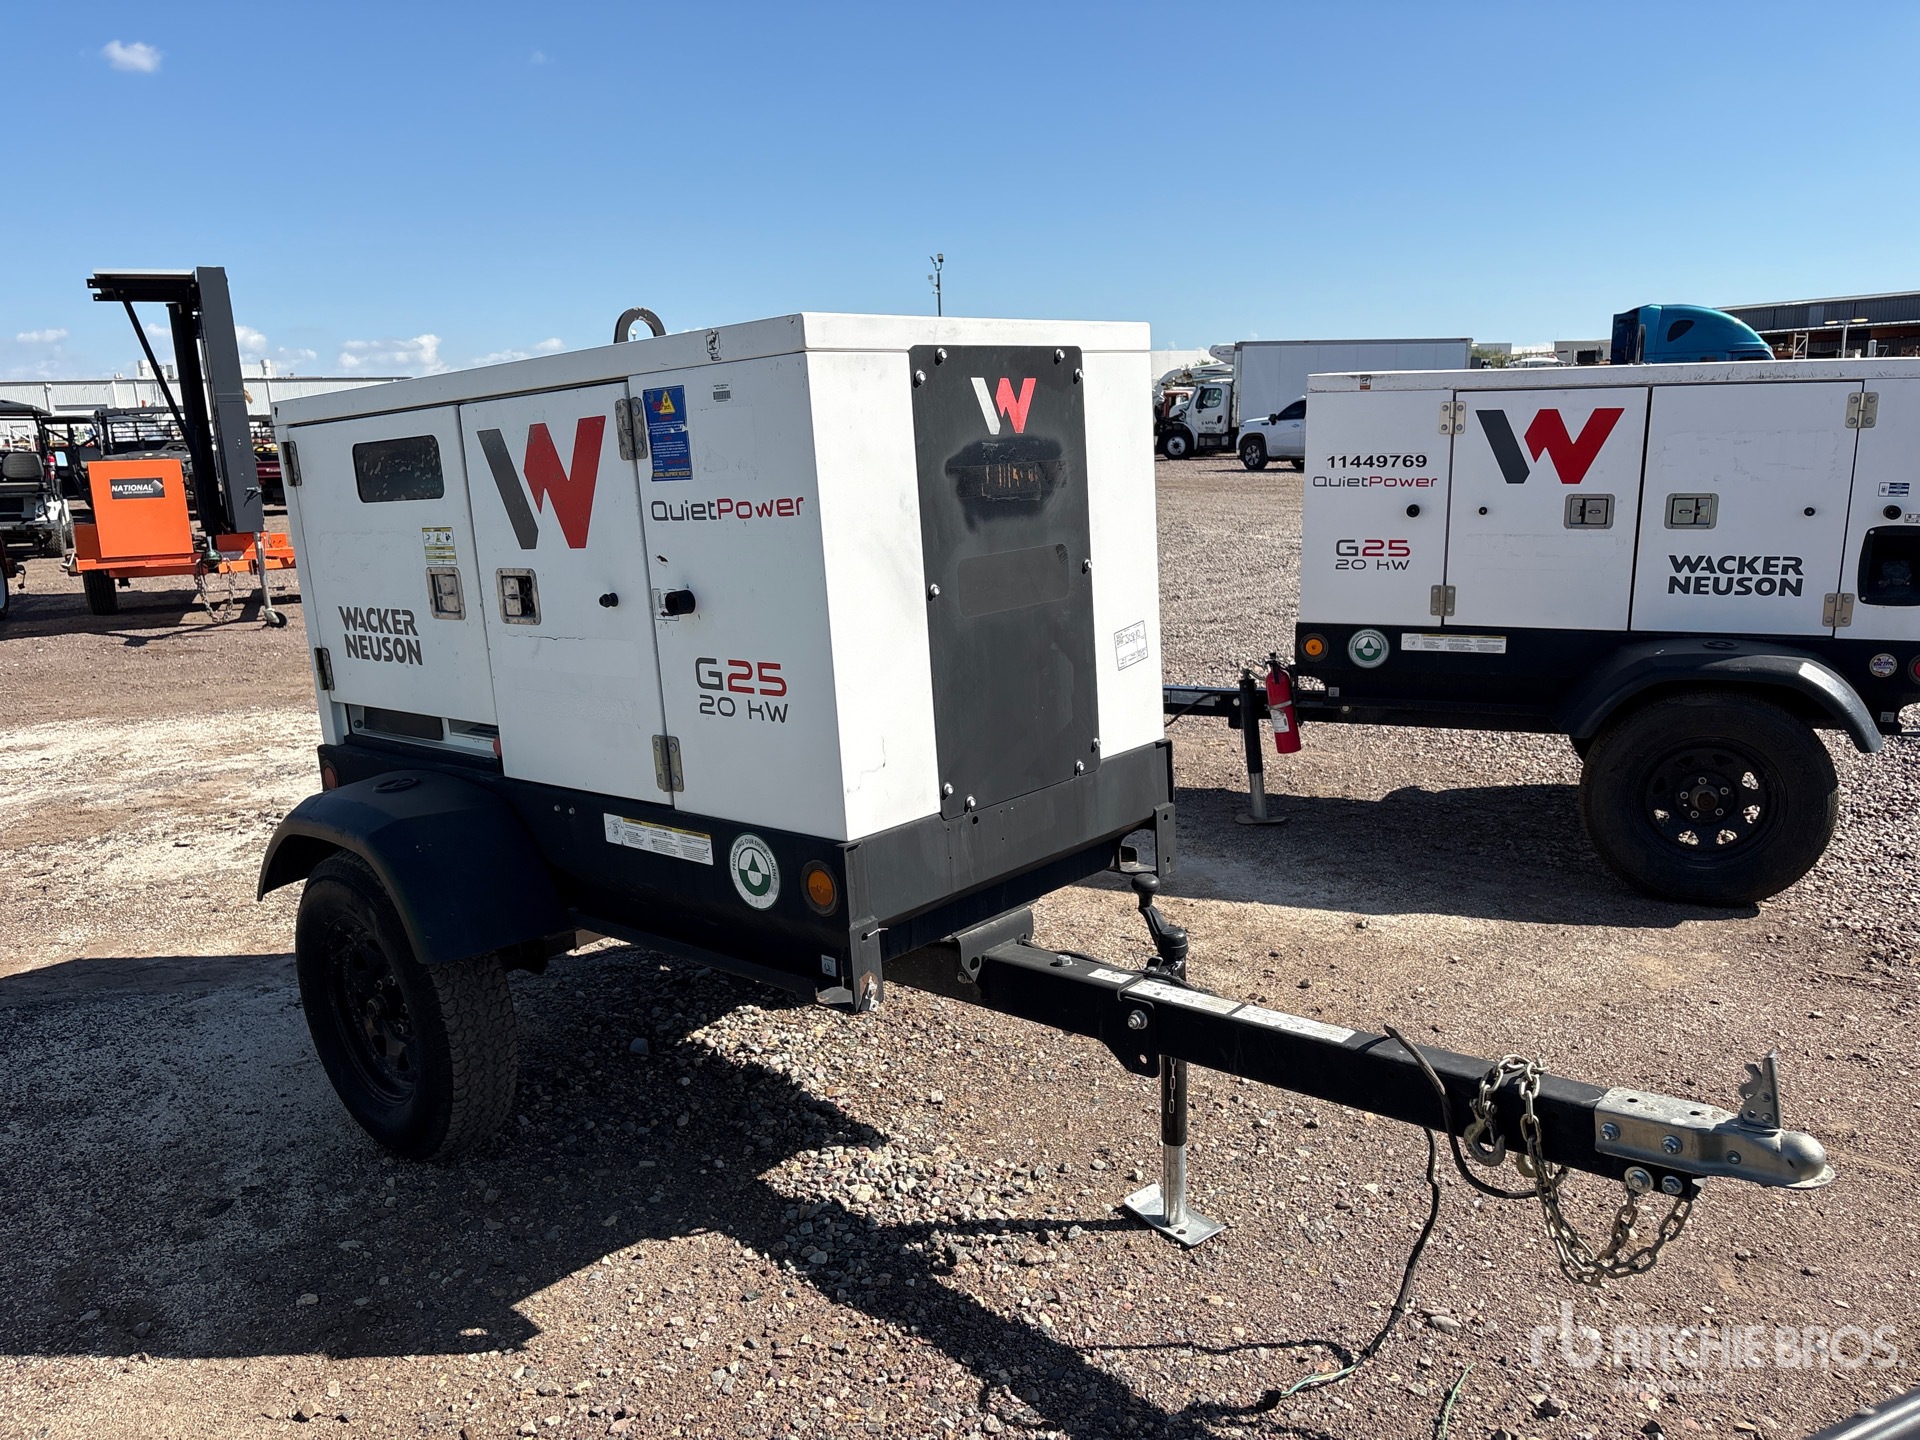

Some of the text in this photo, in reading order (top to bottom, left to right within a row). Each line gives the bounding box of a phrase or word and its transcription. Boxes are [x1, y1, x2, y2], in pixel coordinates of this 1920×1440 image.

[1326, 454, 1428, 469] 11449769
[111, 484, 154, 492] NATIONAL
[1312, 476, 1438, 488] QuietPower
[650, 496, 804, 522] QuietPower
[1335, 539, 1411, 557] G25
[1335, 559, 1367, 570] 20
[1668, 555, 1804, 576] WACKER
[1667, 576, 1804, 597] NEUSON
[337, 606, 419, 636] WACKER
[344, 633, 423, 666] NEUSON
[695, 657, 787, 697] G25
[699, 694, 736, 717] 20
